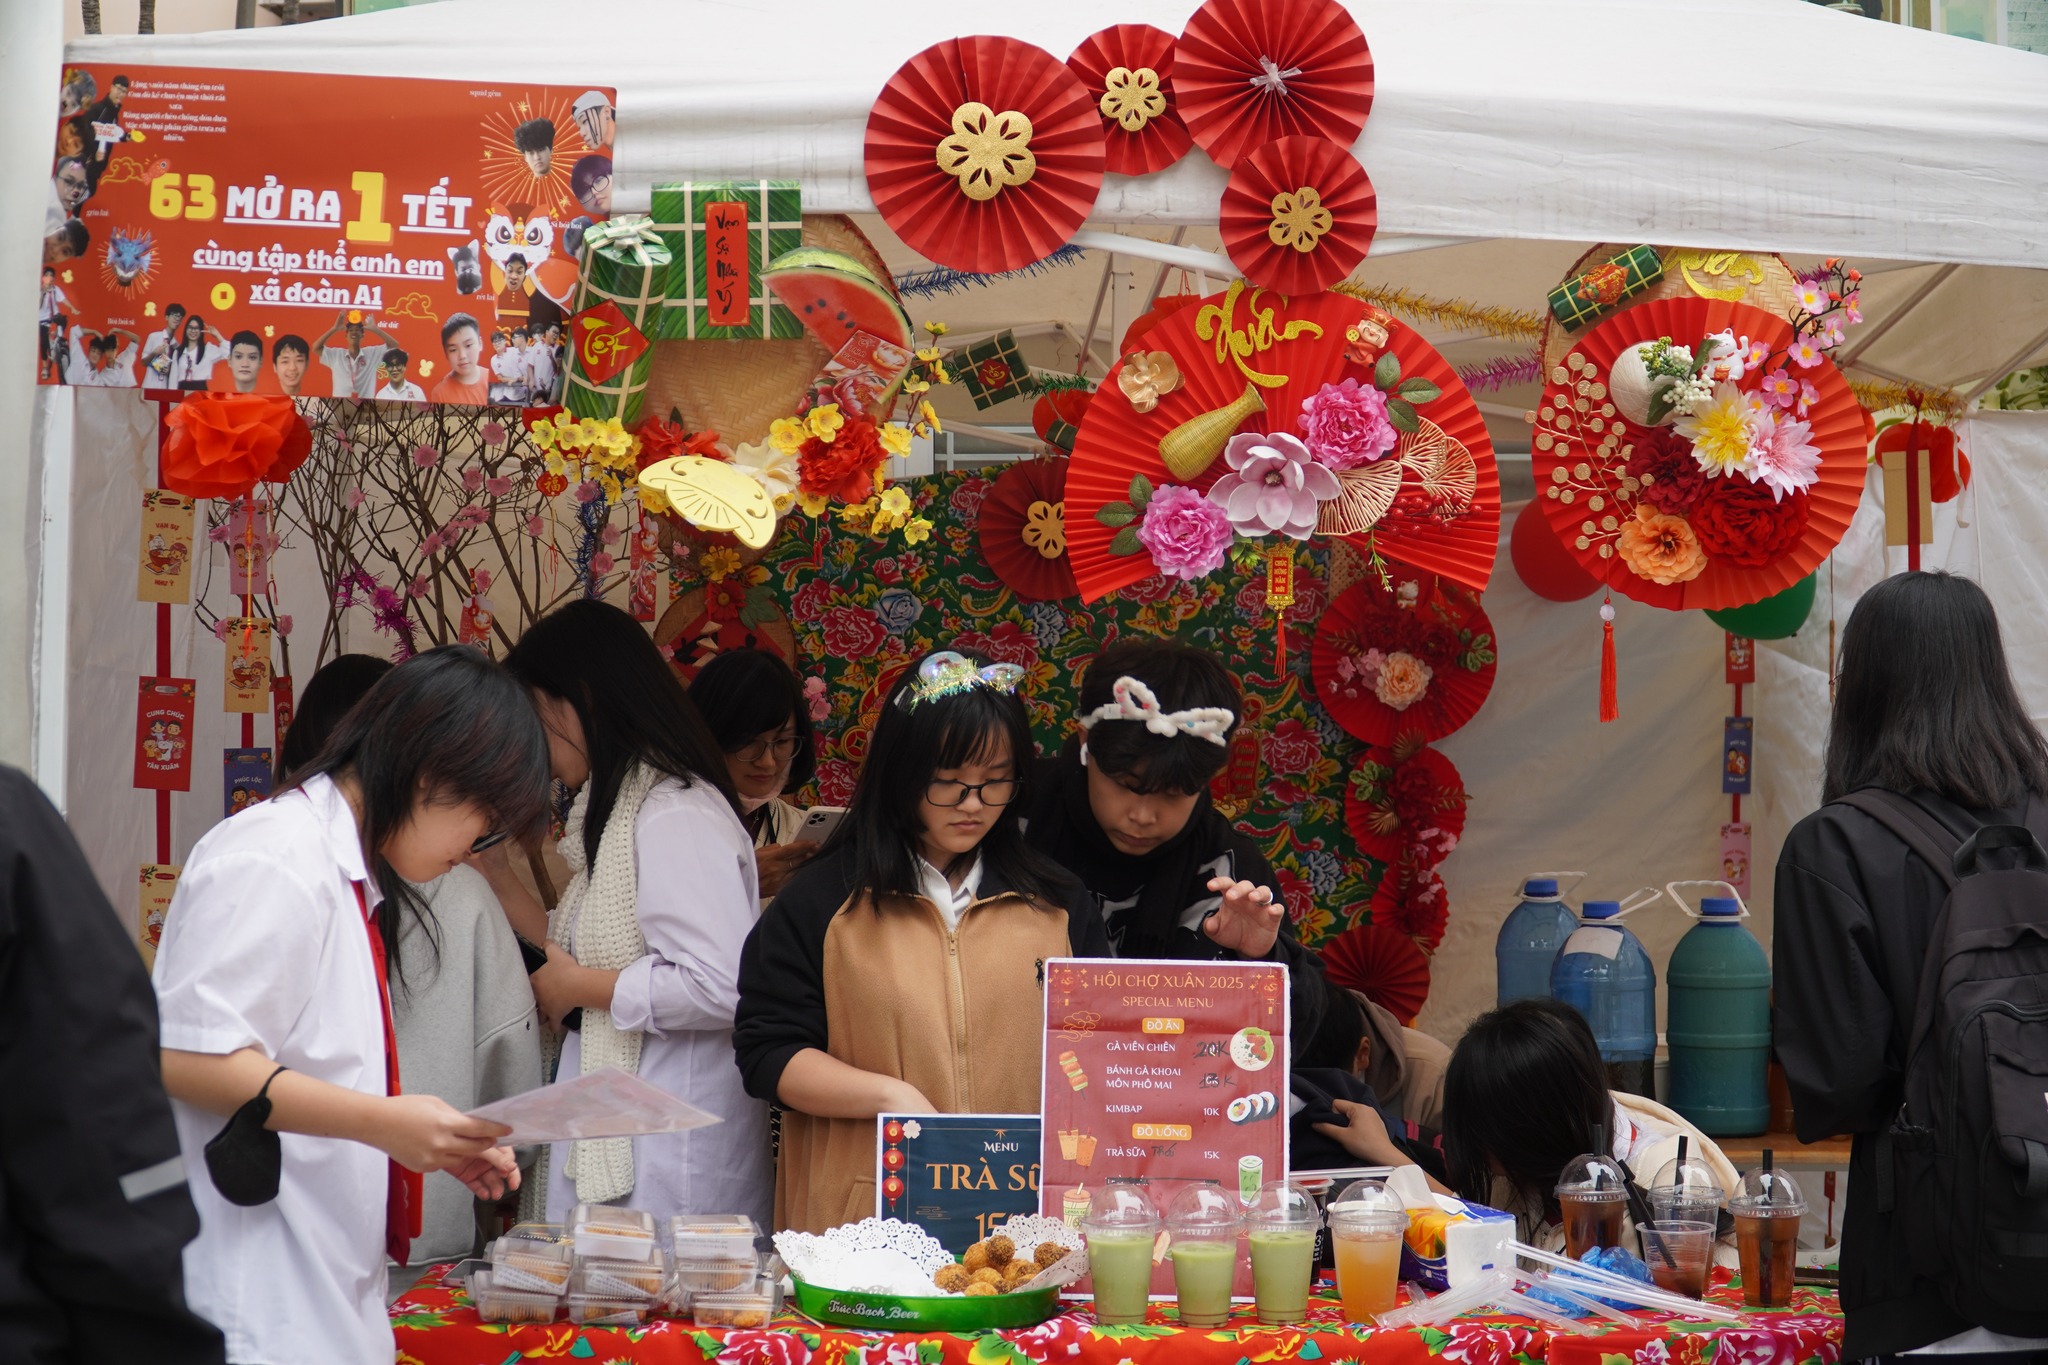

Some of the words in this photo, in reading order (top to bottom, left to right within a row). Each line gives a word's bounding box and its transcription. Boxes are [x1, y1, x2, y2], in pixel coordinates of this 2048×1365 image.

[150, 173, 217, 219] 63
[226, 175, 284, 218] MỞ
[290, 189, 340, 222] RA
[346, 171, 392, 242] 1
[402, 176, 472, 228] TẾT
[193, 240, 253, 272] cùng
[258, 244, 301, 275] tập
[306, 240, 346, 271] thể
[351, 252, 401, 274] anh
[405, 259, 444, 276] em
[250, 278, 280, 302] xã
[284, 278, 350, 304] đoàn
[354, 284, 382, 305] A1
[583, 316, 632, 368] Tết
[146, 709, 165, 718] CUNG
[166, 710, 185, 720] CHÚC
[146, 762, 159, 770] TÂN
[161, 762, 180, 770] XUÂN
[234, 776, 250, 784] PHÚC
[1094, 970, 1121, 989] HỘI
[1125, 974, 1160, 990] CHỢ
[1163, 972, 1205, 988] XUÂN
[1209, 976, 1244, 989] 2025
[1122, 996, 1173, 1008] SPECIAL
[1176, 997, 1214, 1008] MENU
[1146, 1018, 1163, 1030] ĐỒ
[1165, 1019, 1180, 1030] ĂN
[1106, 1040, 1121, 1051] GÀ
[1122, 1041, 1145, 1051] VIÊN
[1146, 1041, 1176, 1052] CHIÊN
[1106, 1064, 1132, 1075] BÁNH
[1135, 1065, 1149, 1076] GÀ
[1151, 1067, 1181, 1076] KHOAI
[1106, 1078, 1130, 1088] MÔN
[1132, 1079, 1152, 1089] PHÔ
[1154, 1081, 1172, 1089] MAI
[1106, 1104, 1142, 1113] KIMBAP
[1203, 1107, 1219, 1116] 10K
[1137, 1125, 1153, 1136] ĐỒ
[1156, 1125, 1188, 1138] UỐNG
[984, 1142, 1019, 1153] MENU
[1106, 1146, 1124, 1157] TRÀ
[1126, 1147, 1146, 1157] SỮA
[1204, 1151, 1220, 1159] 15K
[926, 1157, 999, 1190] TRÀ
[828, 1300, 851, 1313] Trúc
[852, 1303, 886, 1318] Bạch
[886, 1306, 920, 1319] Beer
